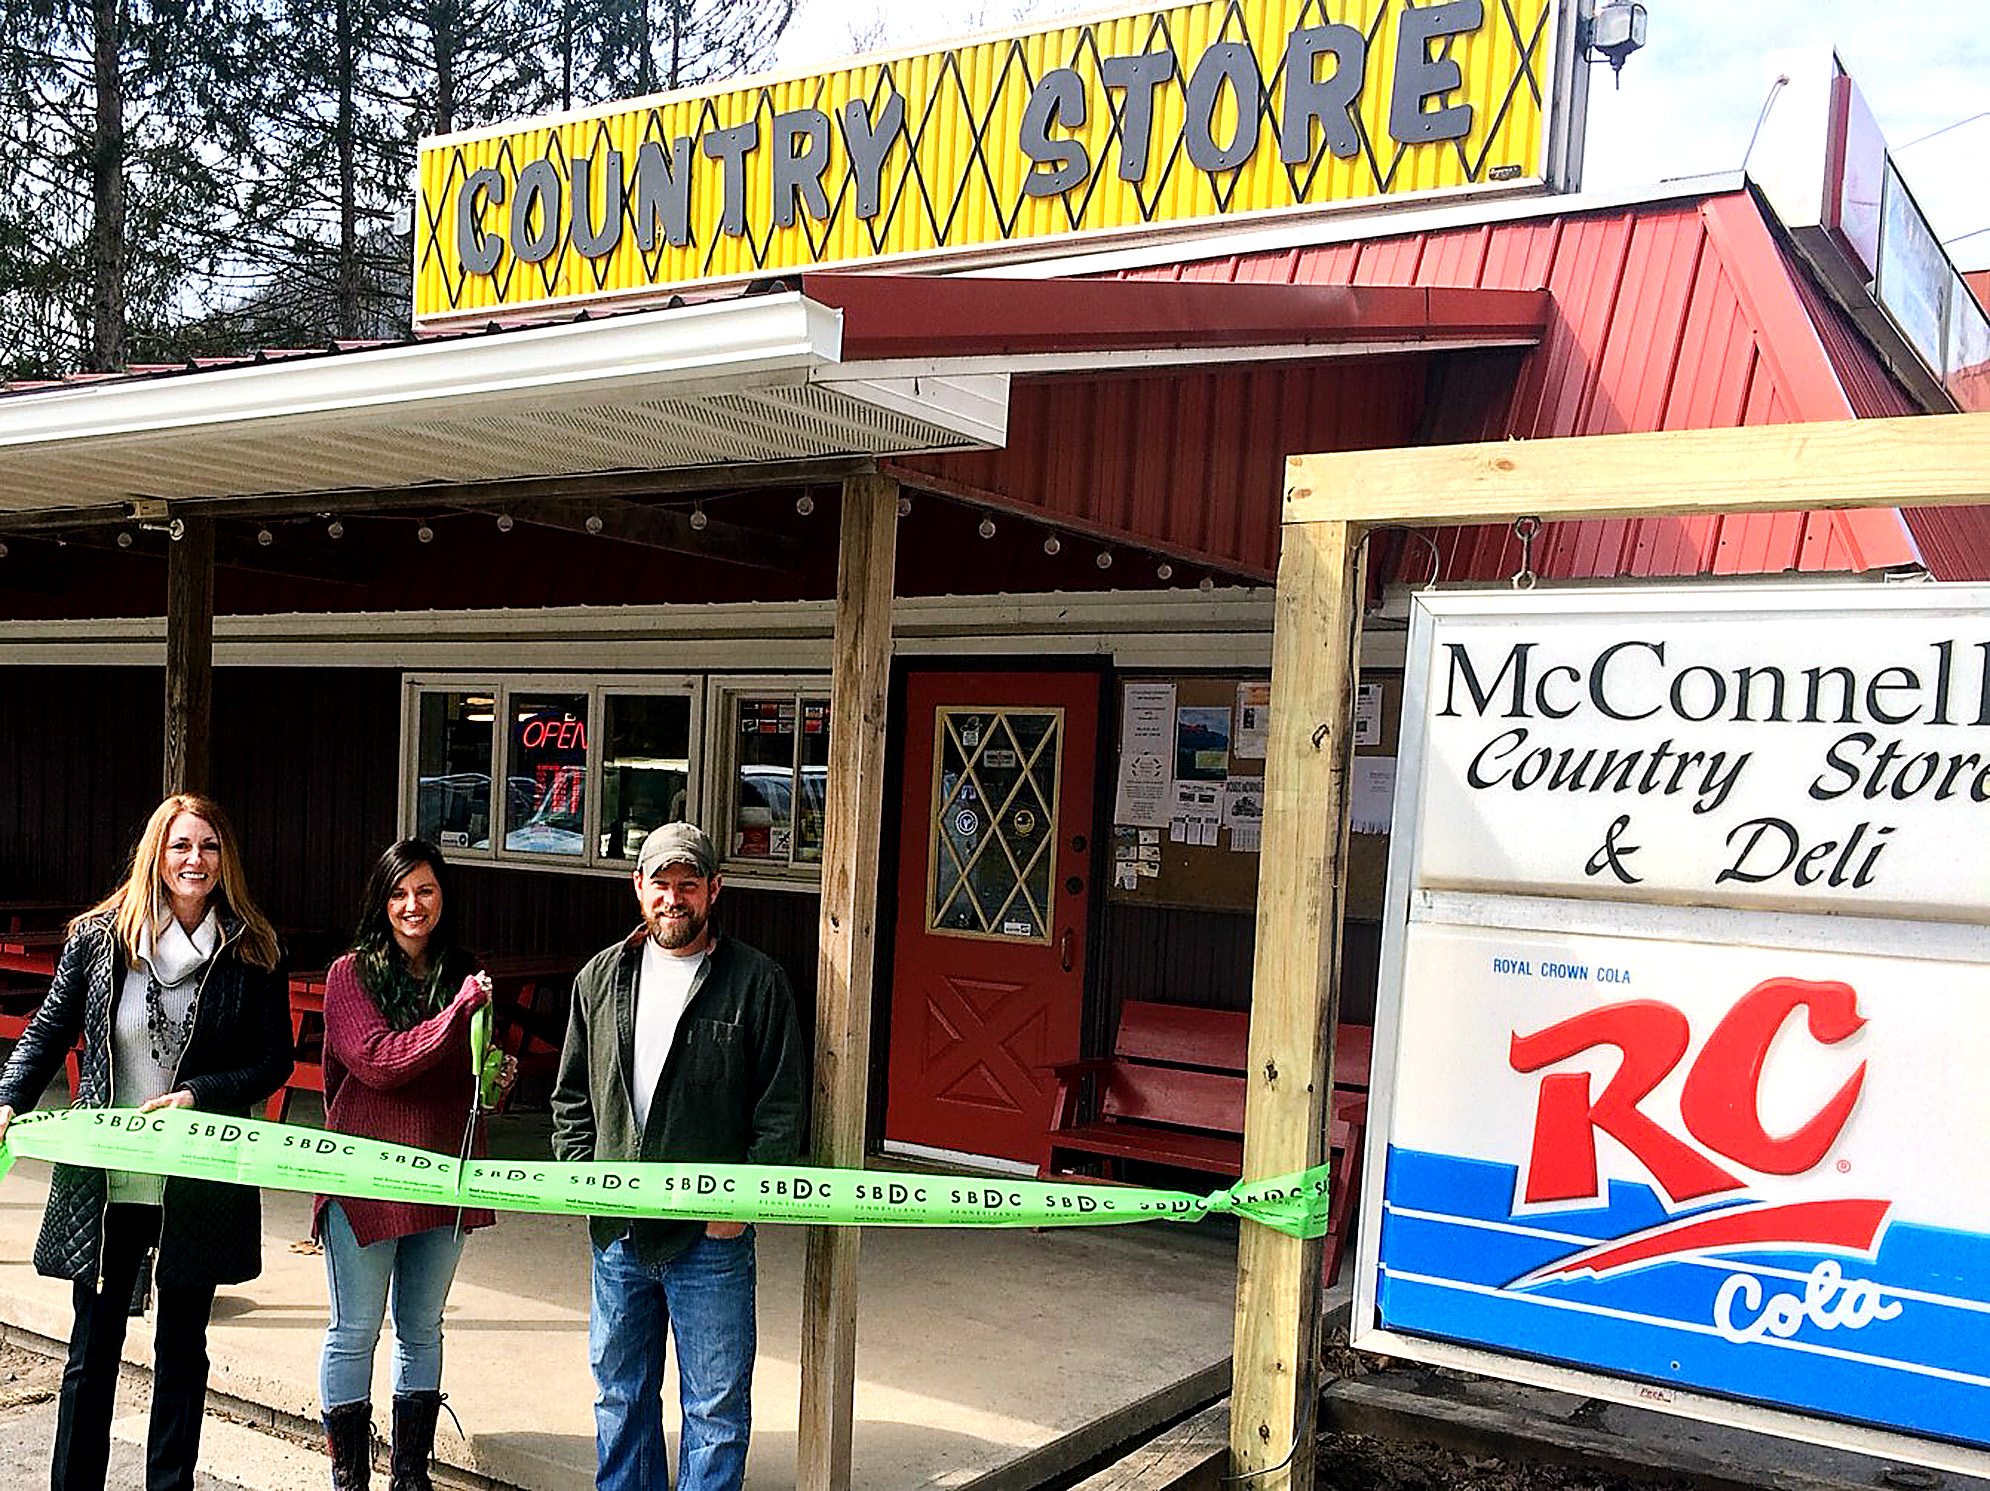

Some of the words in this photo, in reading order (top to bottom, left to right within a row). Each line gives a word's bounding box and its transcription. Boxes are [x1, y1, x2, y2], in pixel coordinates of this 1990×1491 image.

[458, 91, 906, 276] COUNTRY
[1020, 0, 1484, 198] STORE
[523, 721, 588, 749] OPEN
[1467, 728, 1753, 814] Country
[1808, 732, 1990, 801] Store
[1585, 814, 1643, 885] &
[1715, 818, 1897, 888] Deli
[1494, 958, 1532, 976] ROYAL
[1541, 962, 1588, 980] CROWN
[1597, 967, 1631, 984] COLA
[1510, 977, 1870, 1204] RC
[94, 1113, 165, 1131] SBDC
[188, 1123, 260, 1142] SBDC
[283, 1136, 356, 1154] SBDC
[379, 1152, 450, 1172] SBDC
[474, 1169, 545, 1181] SBDC
[570, 1174, 640, 1189] SBDC
[665, 1175, 735, 1194] SBDC
[760, 1178, 831, 1199] SBDC
[856, 1184, 927, 1204] SBDC
[951, 1189, 1022, 1208] SBDC
[1046, 1195, 1115, 1212] SBDC
[1714, 1261, 1904, 1343] Cola
